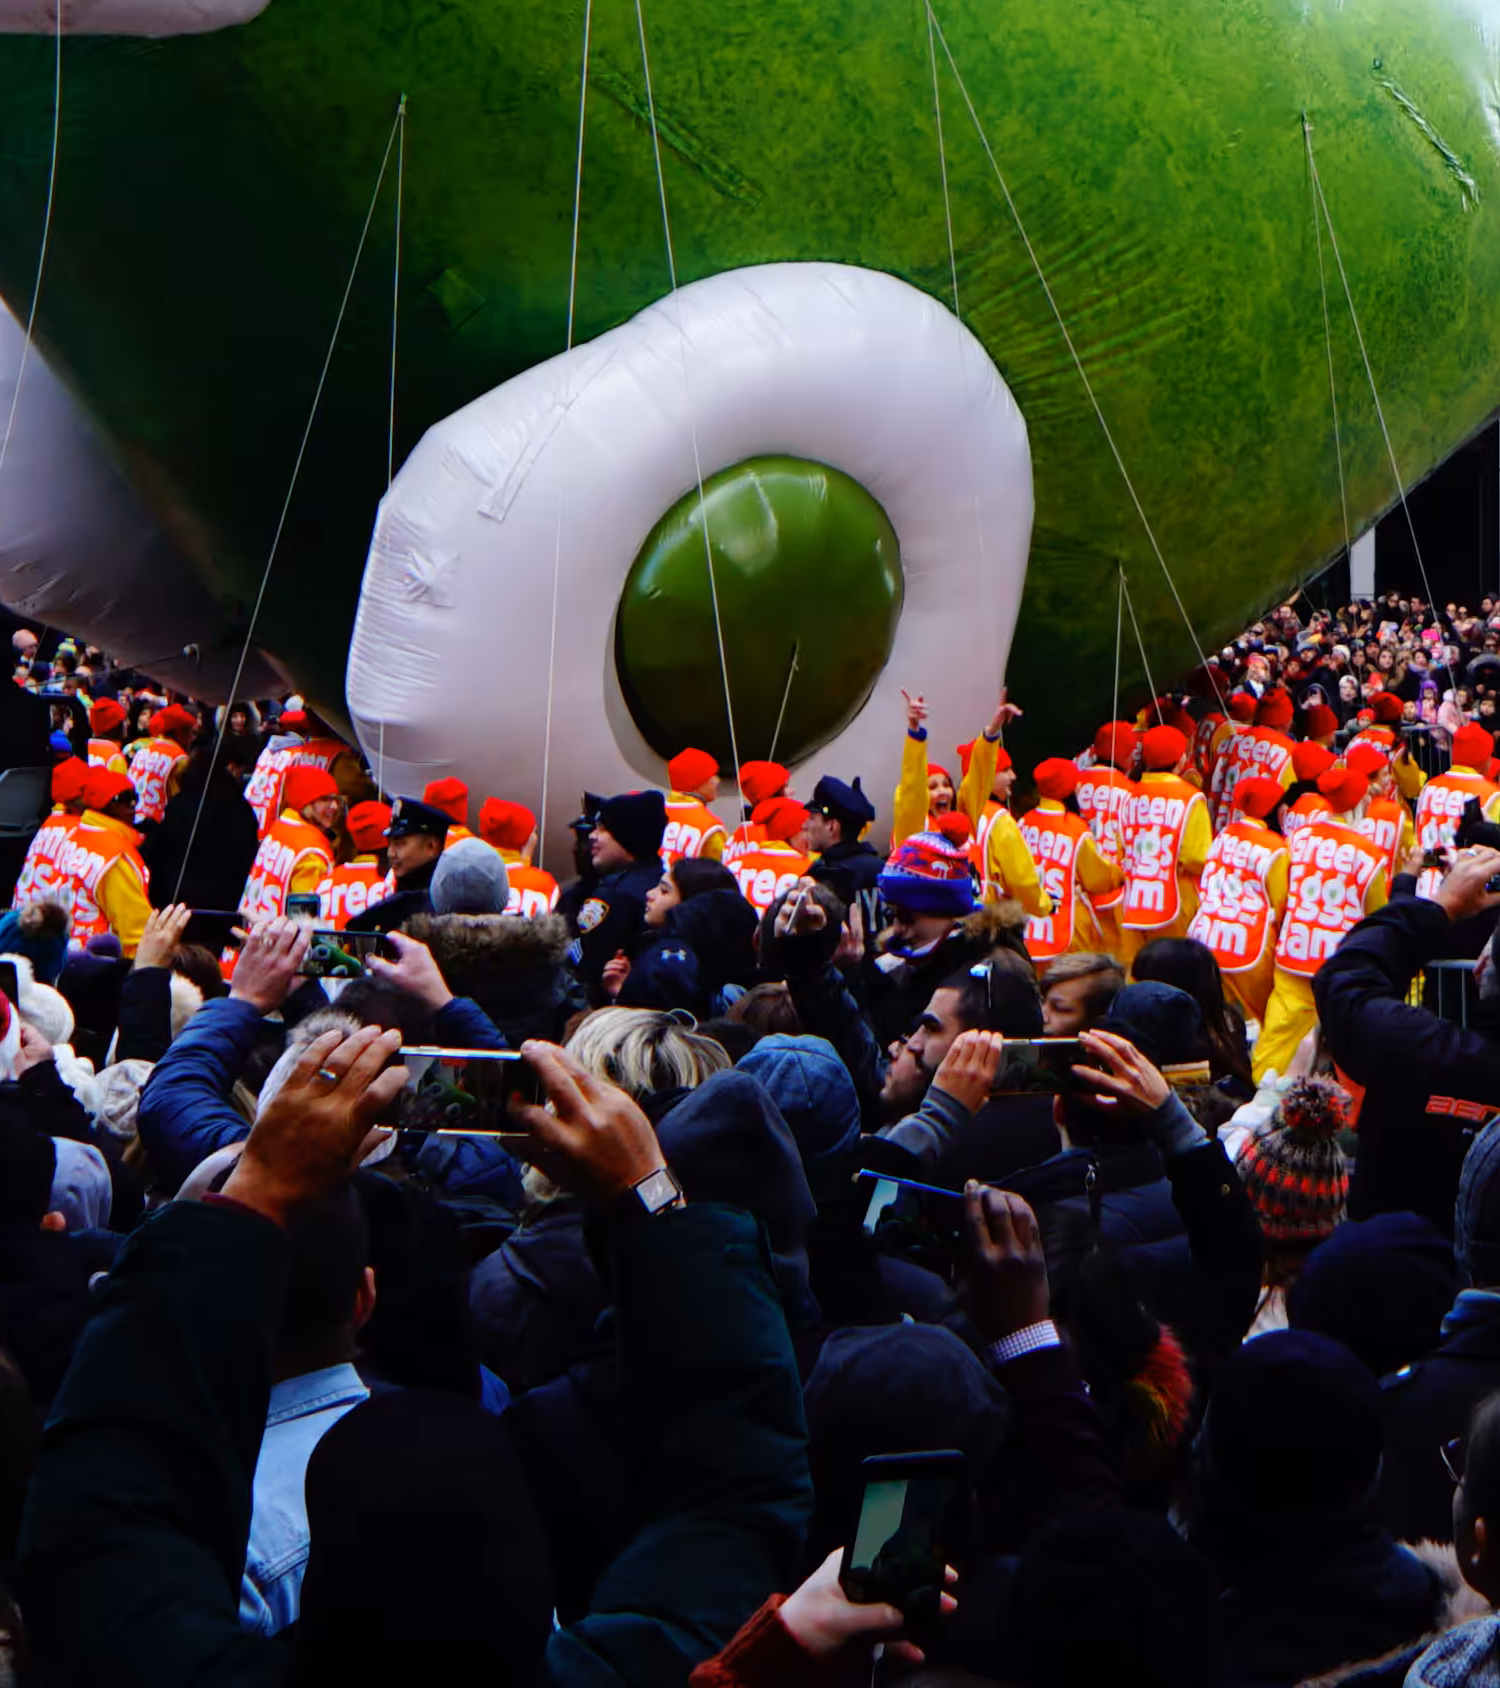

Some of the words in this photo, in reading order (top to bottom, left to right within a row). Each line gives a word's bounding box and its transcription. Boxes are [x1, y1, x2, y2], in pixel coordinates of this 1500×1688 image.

[1077, 782, 1129, 821] een
[1422, 785, 1475, 816] ree
[1018, 817, 1074, 868] een
[1292, 827, 1374, 885] Green
[1289, 864, 1365, 927] Eggs
[1190, 915, 1248, 957] am
